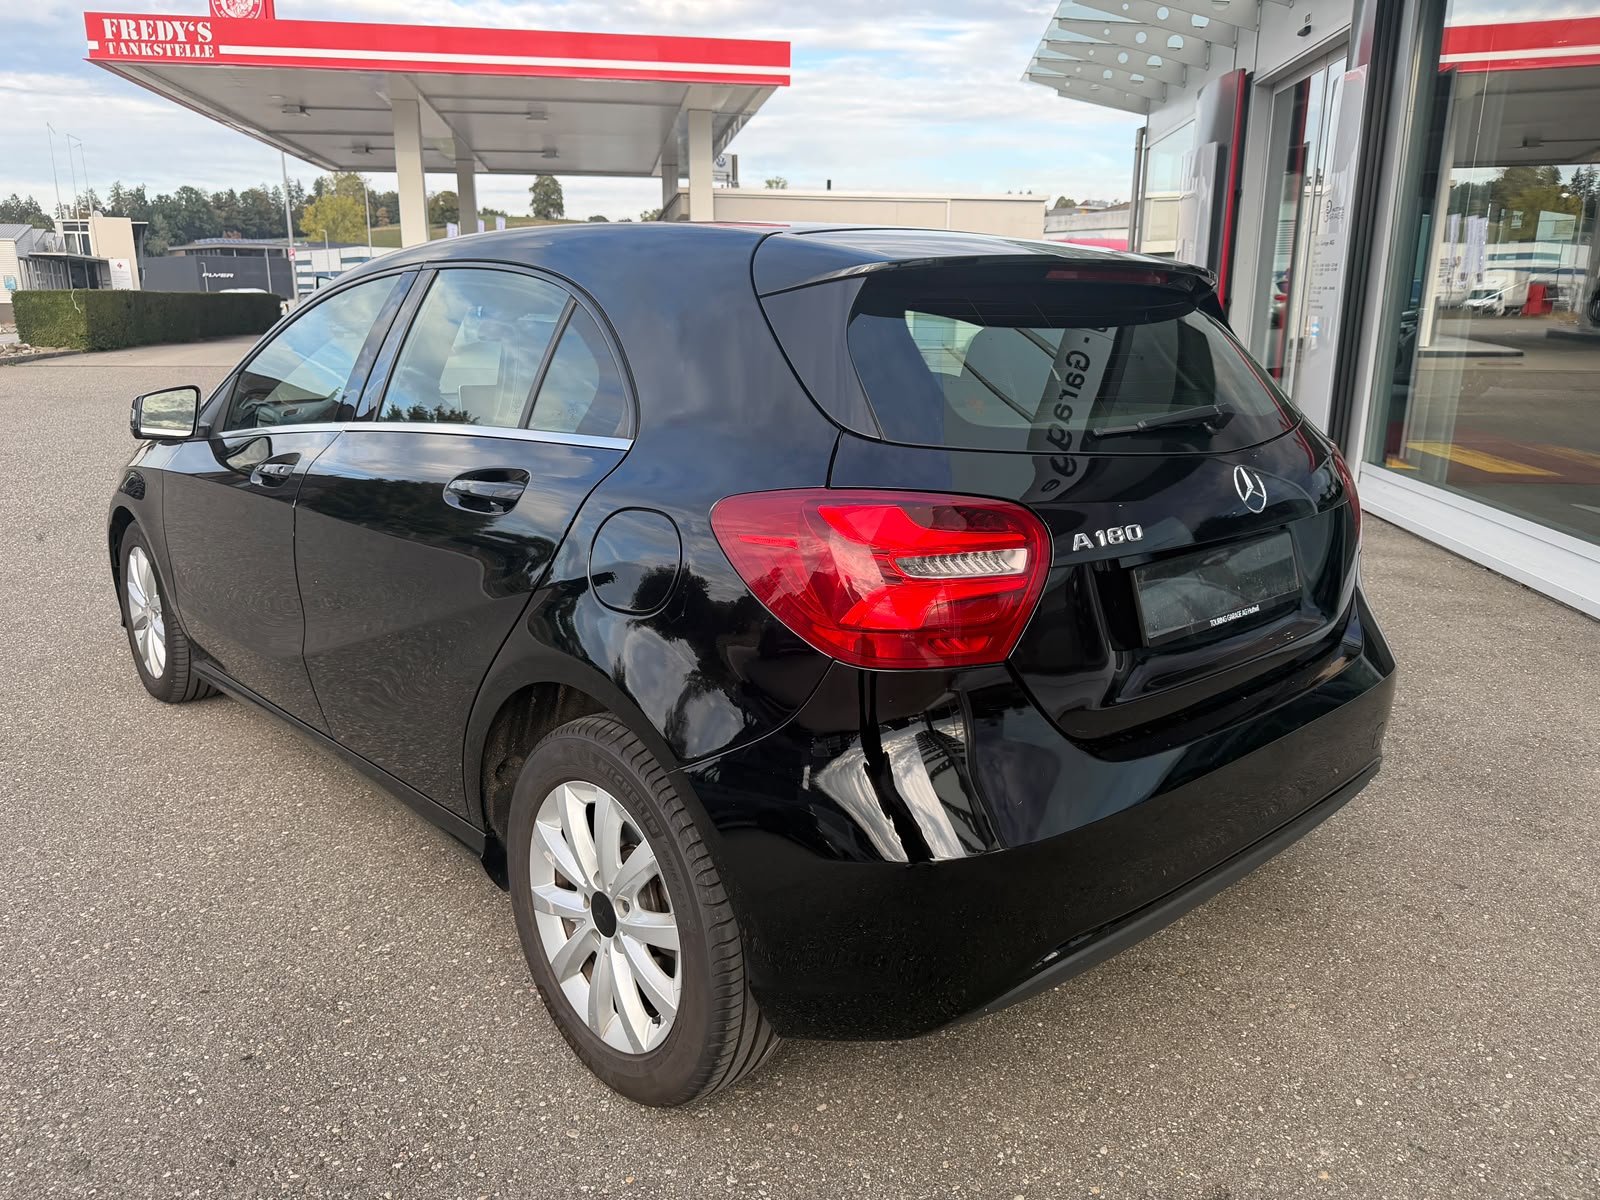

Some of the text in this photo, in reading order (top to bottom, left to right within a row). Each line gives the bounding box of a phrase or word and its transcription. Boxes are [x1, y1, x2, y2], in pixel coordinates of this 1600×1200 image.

[102, 18, 213, 43] FREDY'S
[105, 41, 215, 58] TANKSTELLE
[1072, 523, 1144, 552] A 180
[1227, 611, 1242, 621] GARAGE
[595, 758, 662, 838] MICHELIN
